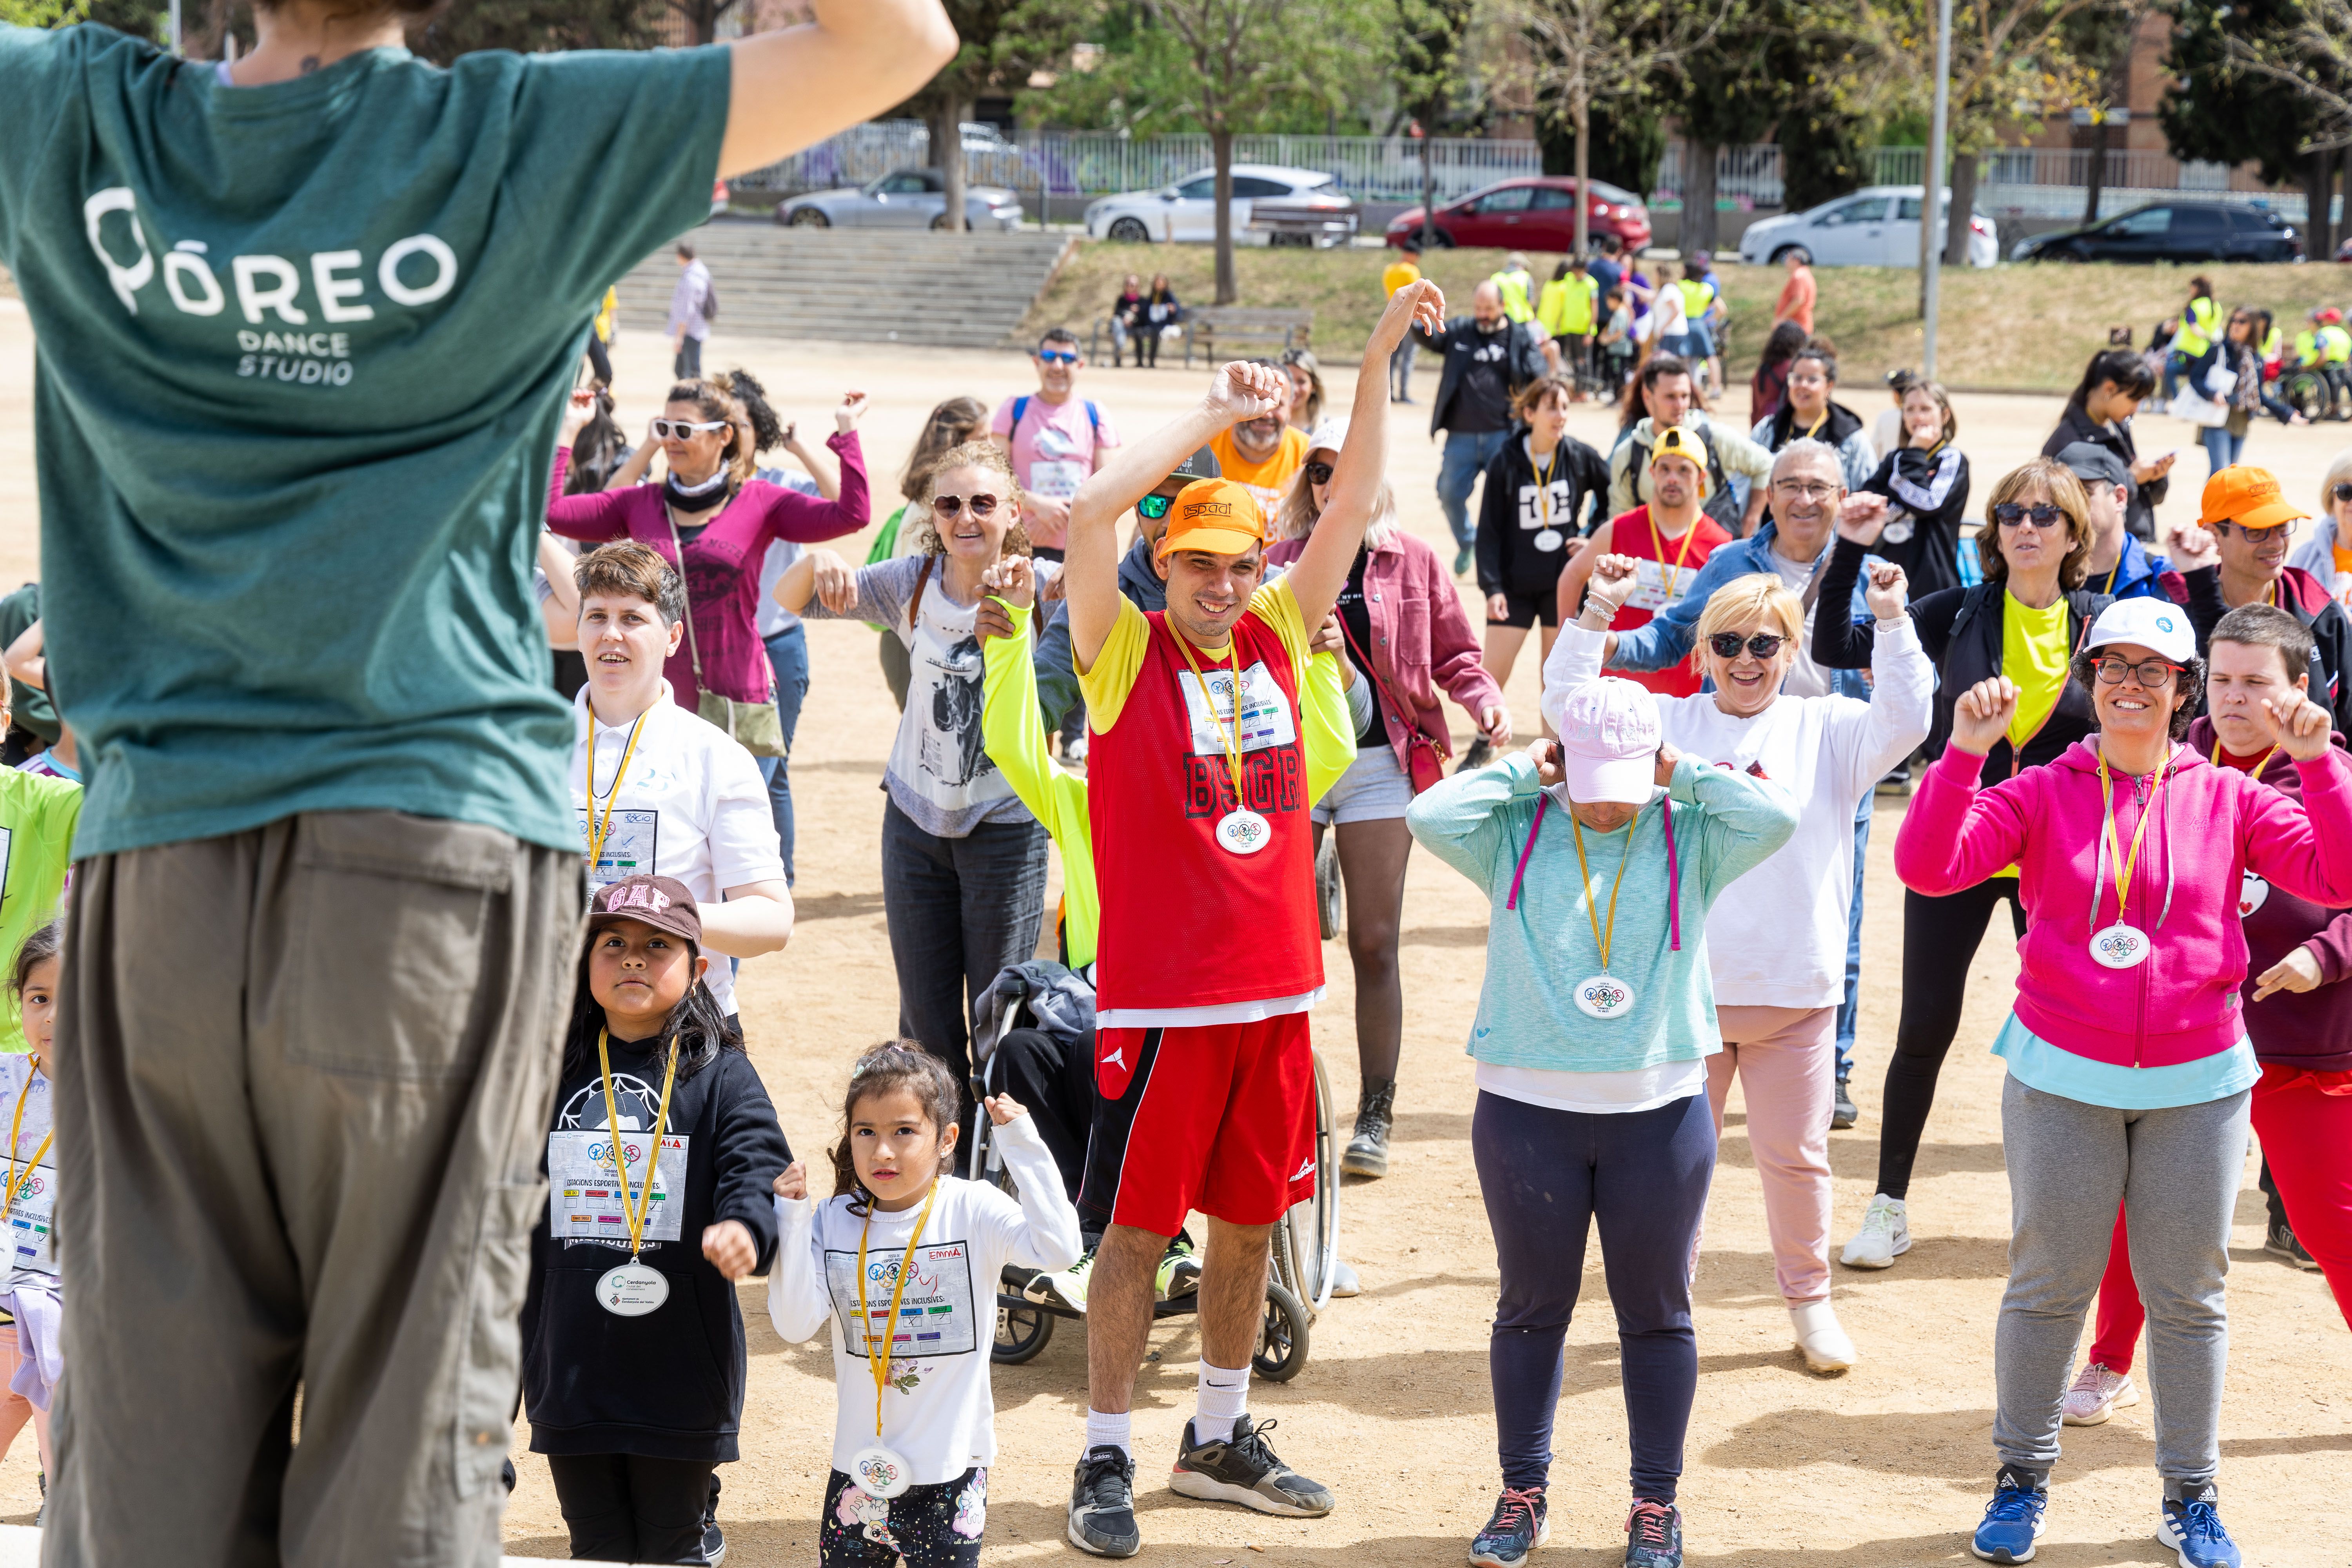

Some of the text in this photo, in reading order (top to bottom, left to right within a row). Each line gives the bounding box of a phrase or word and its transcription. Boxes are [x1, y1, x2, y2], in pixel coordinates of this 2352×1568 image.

[237, 330, 351, 358] DANCE
[236, 355, 353, 386] STUDIO
[929, 658, 966, 671] THE ISSUE
[1183, 746, 1300, 819] BSGR
[607, 885, 670, 914] GAP
